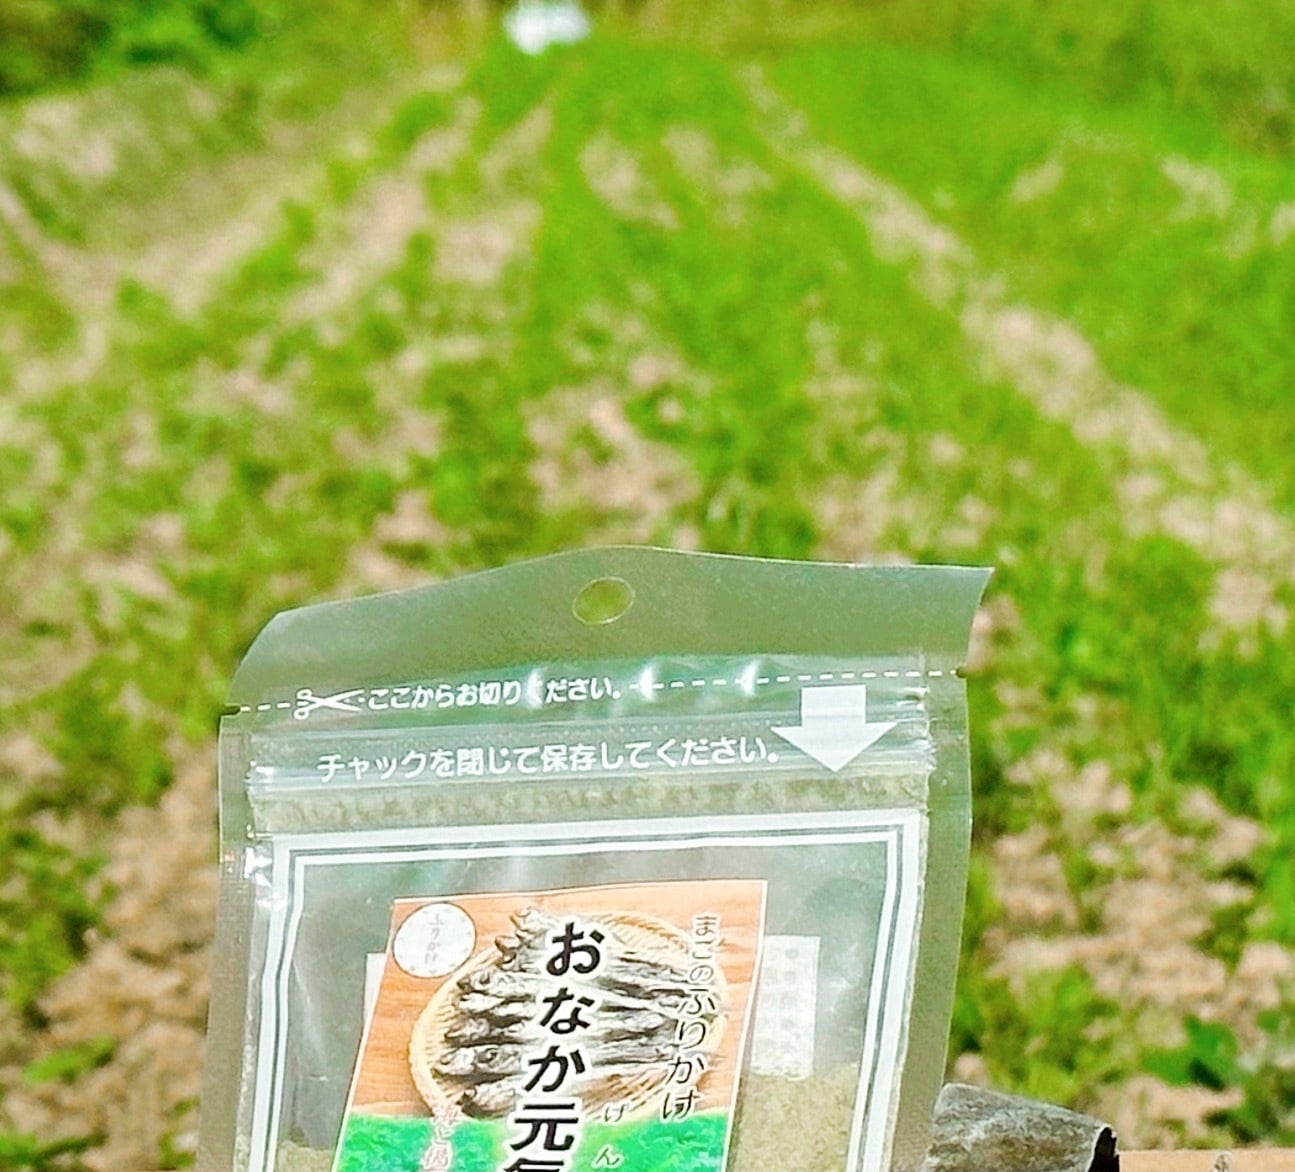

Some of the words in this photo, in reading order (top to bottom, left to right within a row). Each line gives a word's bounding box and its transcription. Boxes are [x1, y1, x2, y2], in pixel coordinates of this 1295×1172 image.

[317, 737, 780, 783] チャックを閉じて保存してください。
[661, 915, 718, 1120] まこのふりかけ
